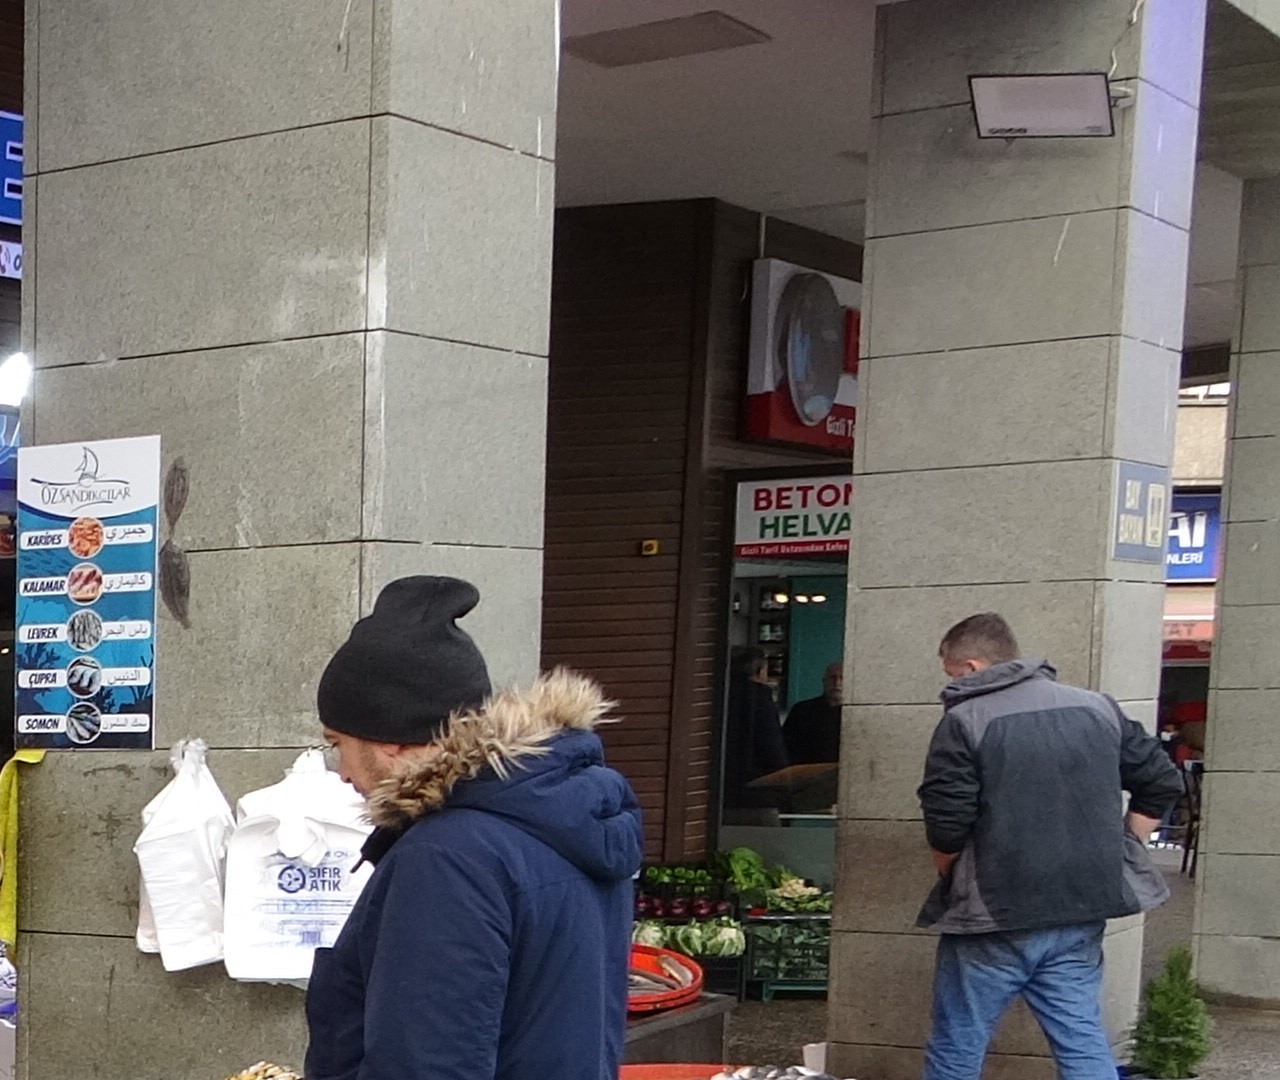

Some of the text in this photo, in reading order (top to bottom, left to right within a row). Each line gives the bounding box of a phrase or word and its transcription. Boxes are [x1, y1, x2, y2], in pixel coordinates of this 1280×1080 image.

[26, 531, 63, 547] KARİDES
[22, 579, 67, 593] KALAMAR
[26, 627, 59, 640] LEVREK
[28, 672, 58, 688] ÇUPRA
[25, 718, 61, 731] SOMON
[308, 867, 342, 879] SIFIR
[308, 879, 342, 892] ATIK
